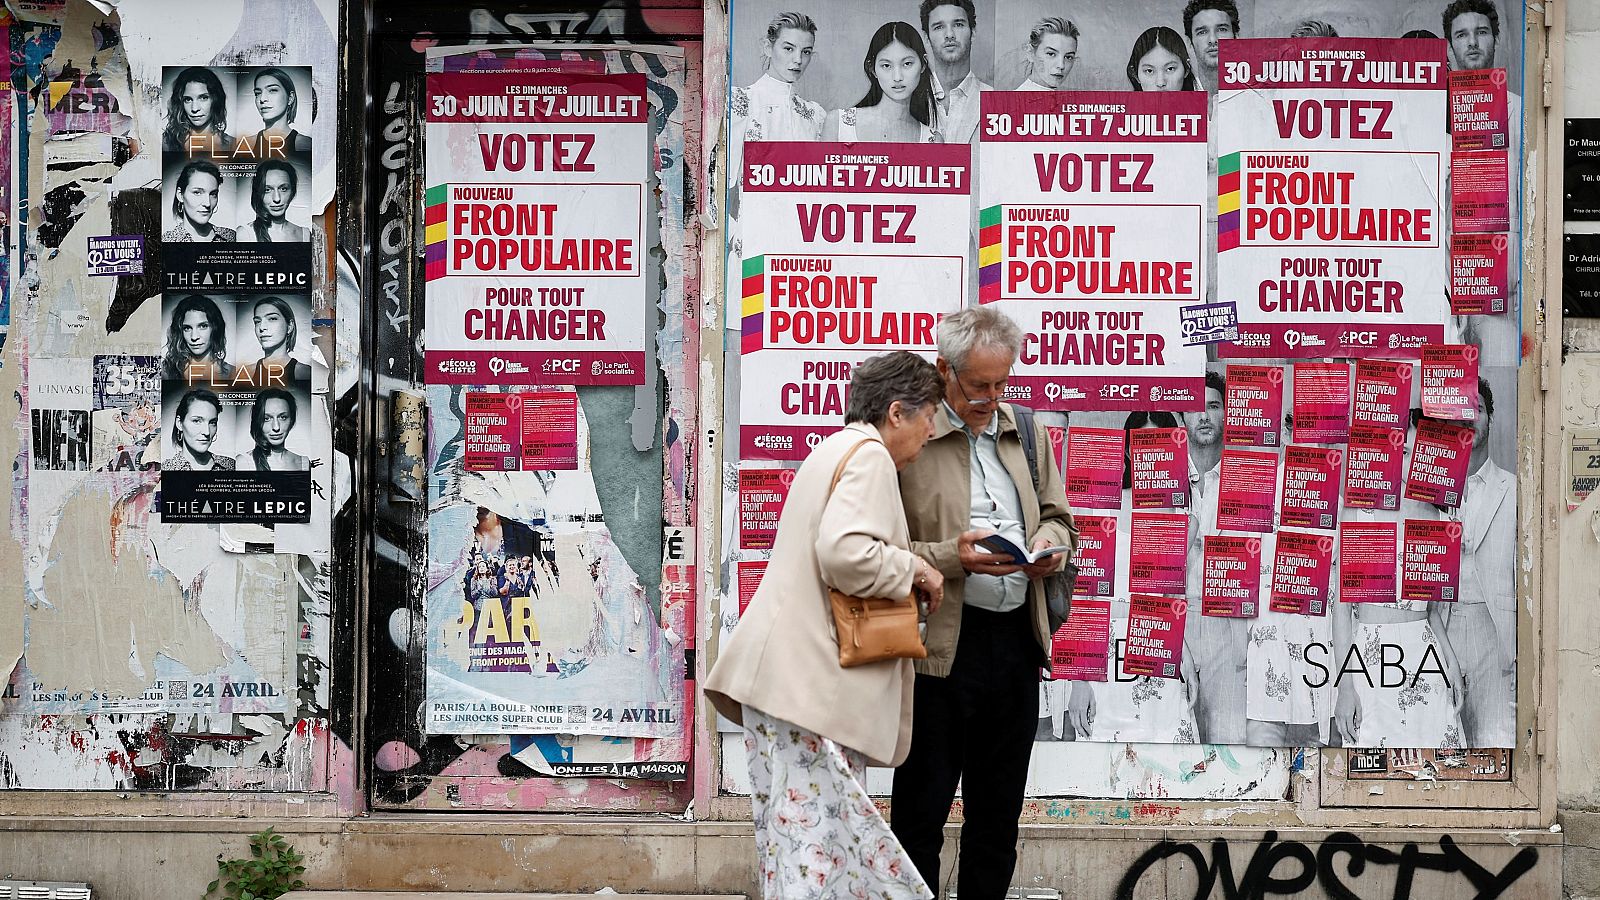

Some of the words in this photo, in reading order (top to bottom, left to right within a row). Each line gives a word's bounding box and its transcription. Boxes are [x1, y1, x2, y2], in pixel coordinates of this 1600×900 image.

[1302, 51, 1317, 59] LES
[1318, 51, 1366, 60] DIMANCHES
[1224, 62, 1250, 83] 30
[1255, 61, 1304, 83] JUIN
[1309, 61, 1335, 83] ET
[1341, 61, 1353, 82] 7
[1357, 61, 1441, 84] JUILLET
[506, 86, 521, 94] LES
[523, 86, 568, 94] DIMANCHES
[1453, 96, 1461, 104] LE
[1462, 94, 1493, 103] NOUVEAU
[432, 96, 457, 117] 30
[461, 96, 508, 117] JUIN
[513, 96, 539, 117] ET
[540, 96, 555, 117] 7
[560, 96, 642, 117] JUILLET
[1062, 104, 1078, 113] LES
[1079, 104, 1126, 113] DIMANCHES
[1453, 104, 1475, 113] FRONT
[1272, 99, 1393, 139] VOTEZ
[1454, 112, 1489, 122] POPULAIRE
[986, 114, 1012, 136] 30
[1016, 114, 1065, 136] JUIN
[1069, 114, 1096, 136] ET
[1100, 115, 1114, 136] 7
[1117, 114, 1202, 136] JUILLET
[1454, 122, 1470, 131] PEUT
[1471, 121, 1499, 131] GAGNER
[189, 135, 286, 158] FLAIR
[478, 133, 596, 172] VOTEZ
[825, 155, 842, 163] LES
[843, 155, 889, 164] DIMANCHES
[1247, 155, 1309, 168] NOUVEAU
[749, 164, 775, 186] 30
[780, 165, 827, 186] JUIN
[832, 166, 859, 187] ET
[863, 166, 877, 187] 7
[881, 166, 965, 188] JUILLET
[1033, 153, 1154, 193] VOTEZ
[1582, 174, 1595, 182] Tél.
[454, 188, 514, 201] NOUVEAU
[1247, 172, 1355, 205] FRONT
[454, 204, 557, 236] FRONT
[1008, 208, 1070, 222] NOUVEAU
[796, 204, 917, 243] VOTEZ
[1247, 207, 1431, 241] POPULAIRE
[90, 241, 115, 249] MACHOS
[1008, 225, 1116, 258] FRONT
[104, 249, 113, 259] ET
[114, 248, 135, 259] VOUS
[453, 238, 633, 271] POPULAIRE
[1569, 254, 1580, 262] Dr
[771, 259, 832, 272] NOUVEAU
[1280, 258, 1329, 277] POUR
[1334, 258, 1382, 277] TOUT
[254, 273, 307, 285] LEPIC
[1008, 260, 1193, 295] POPULAIRE
[486, 288, 533, 306] POUR
[538, 288, 585, 306] TOUT
[770, 275, 877, 309] FRONT
[1258, 280, 1403, 313] CHANGER
[1041, 311, 1090, 330] POUR
[1095, 311, 1144, 330] TOUT
[1183, 309, 1208, 319] MACHOS
[464, 309, 606, 341] CHANGER
[1198, 318, 1206, 328] ET
[1207, 315, 1229, 327] VOUS
[1243, 331, 1271, 340] ÉCOLO
[1350, 332, 1378, 345] PCF
[1019, 333, 1166, 366] CHANGER
[450, 358, 477, 367] ÉCOLO
[553, 359, 582, 372] PCF
[189, 364, 286, 387] FLAIR
[803, 362, 852, 381] POUR
[106, 366, 135, 395] 35
[1110, 384, 1139, 398] PCF
[468, 417, 475, 426] LE
[477, 417, 507, 425] NOUVEAU
[468, 425, 489, 434] FRONT
[468, 434, 503, 443] POPULAIRE
[766, 433, 793, 442] ÉCOLO
[468, 443, 484, 452] PEUT
[484, 444, 511, 453] GAGNER
[1134, 453, 1141, 461] LE
[1143, 452, 1174, 461] NOUVEAU
[1134, 462, 1155, 471] FRONT
[1134, 471, 1169, 480] POPULAIRE
[1134, 481, 1151, 489] PEUT
[1151, 480, 1179, 489] GAGNER
[253, 501, 306, 514] LEPIC
[488, 647, 503, 655] DES
[472, 657, 498, 667] FRONT
[1302, 642, 1451, 688] SABA
[192, 682, 215, 698] 24
[221, 681, 280, 698] AVRIL
[33, 693, 51, 702] LES
[473, 704, 487, 712] LA
[490, 704, 527, 713] BOULE
[530, 705, 564, 714] NOIRE
[433, 714, 452, 723] LES
[454, 714, 499, 723] INROCKS
[502, 715, 534, 724] SUPER
[537, 715, 563, 724] CLUB
[592, 708, 614, 722] 24
[620, 708, 676, 724] AVRIL
[585, 766, 607, 774] LES
[641, 764, 686, 774] MAISON
